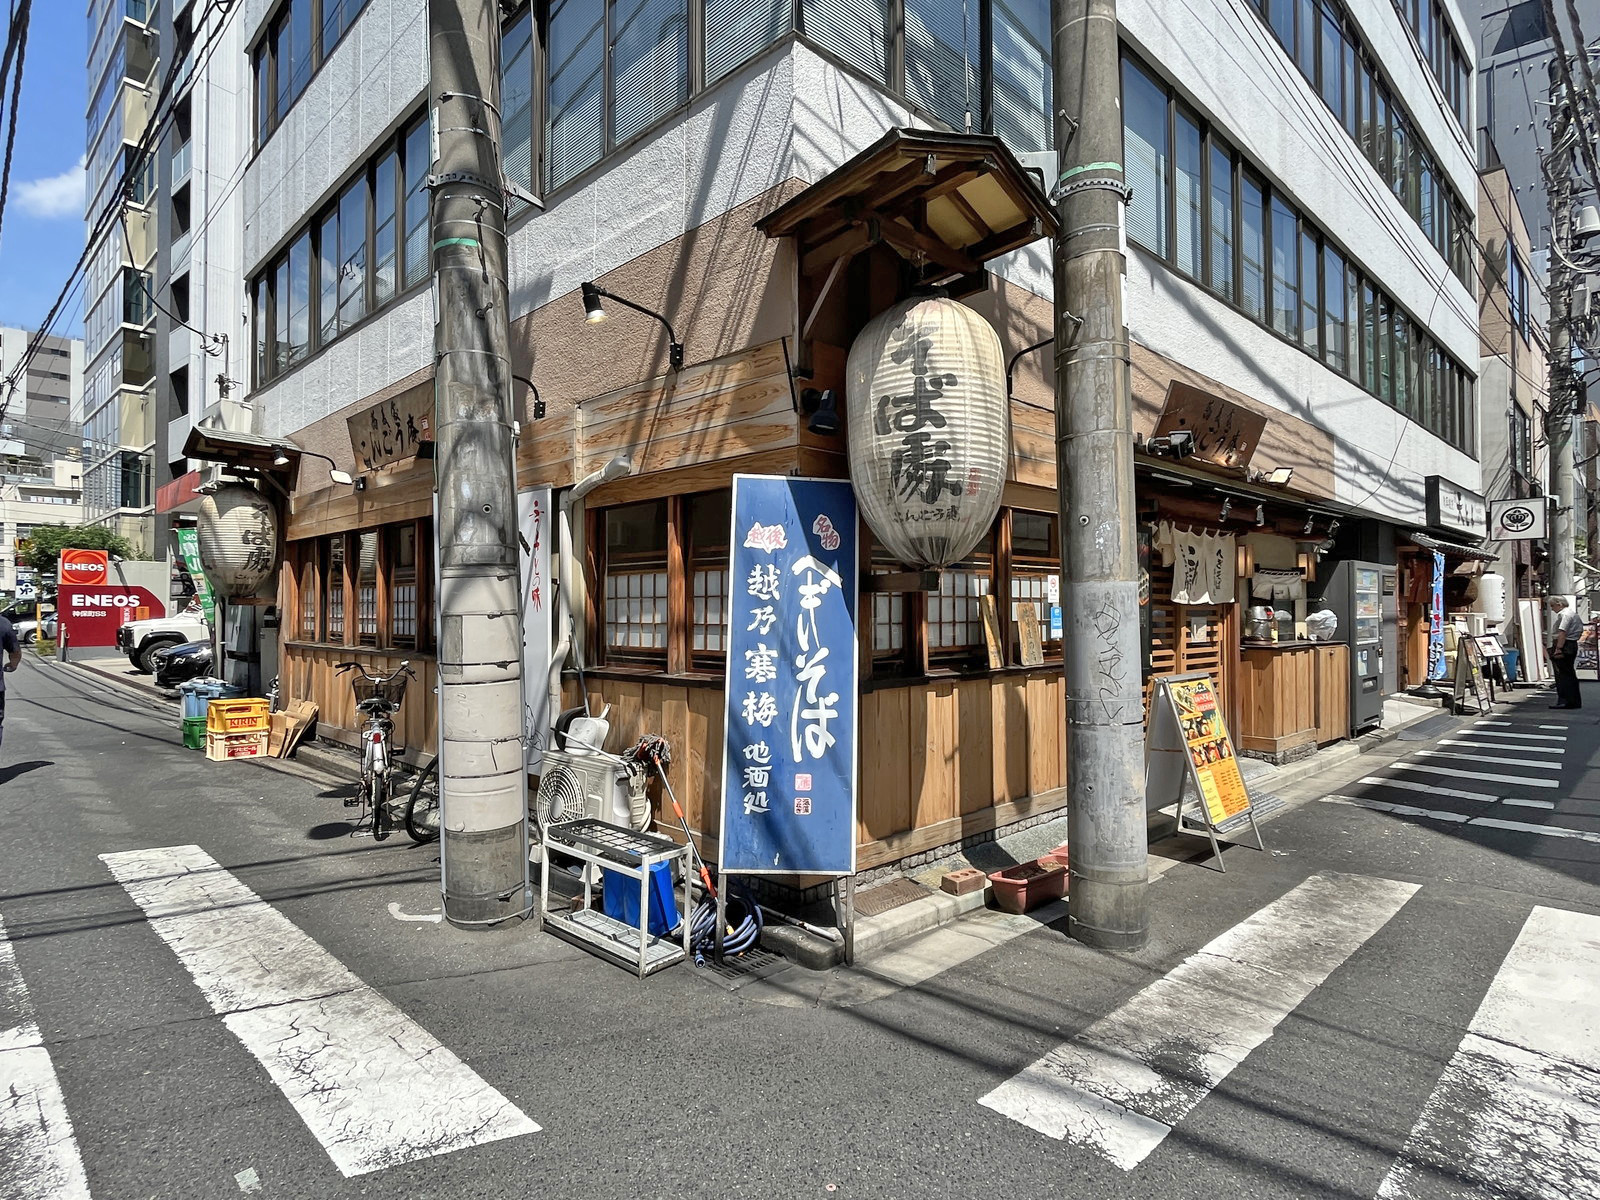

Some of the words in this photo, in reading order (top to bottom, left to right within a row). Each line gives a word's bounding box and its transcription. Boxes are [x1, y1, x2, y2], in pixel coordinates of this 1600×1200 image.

[747, 524, 785, 551] 越後
[815, 515, 839, 549] 名物
[64, 563, 105, 572] ENEOS
[71, 594, 141, 607] ENEOS
[741, 563, 781, 728] 越乃寒梅
[791, 554, 843, 762] へぎそば
[230, 717, 257, 726] KIRIN
[741, 740, 773, 815] 地酒処
